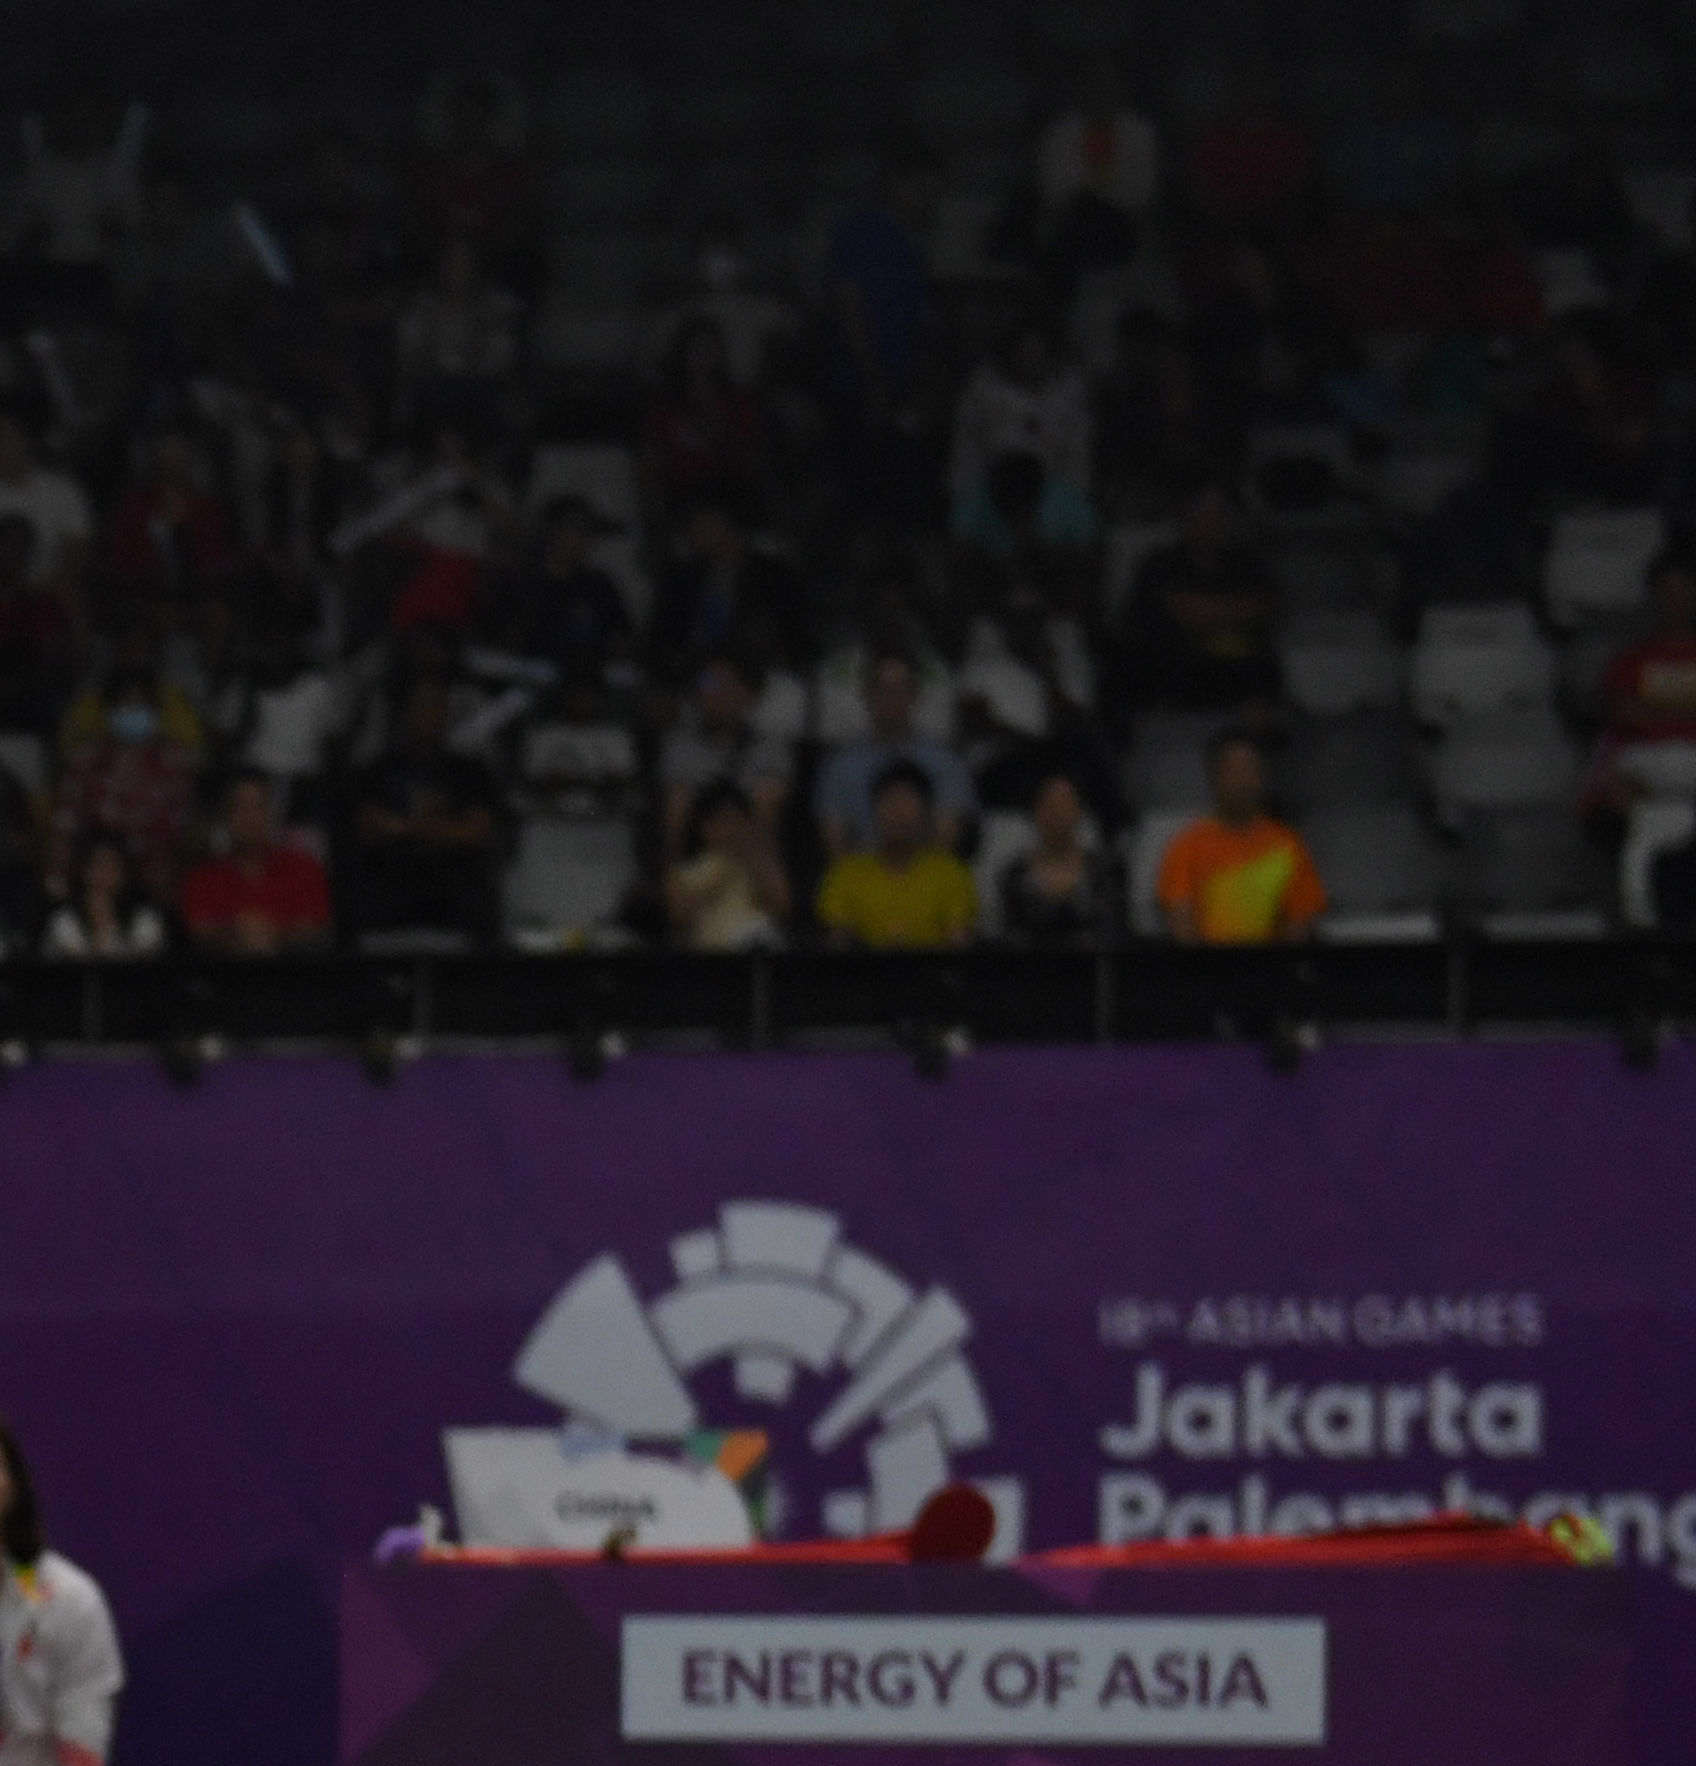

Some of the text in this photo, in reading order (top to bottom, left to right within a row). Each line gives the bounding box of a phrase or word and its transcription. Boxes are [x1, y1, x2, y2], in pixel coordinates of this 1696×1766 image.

[1099, 1362, 1544, 1460] Jakarta
[680, 1649, 1270, 1709] ENERGY OF ASIA
